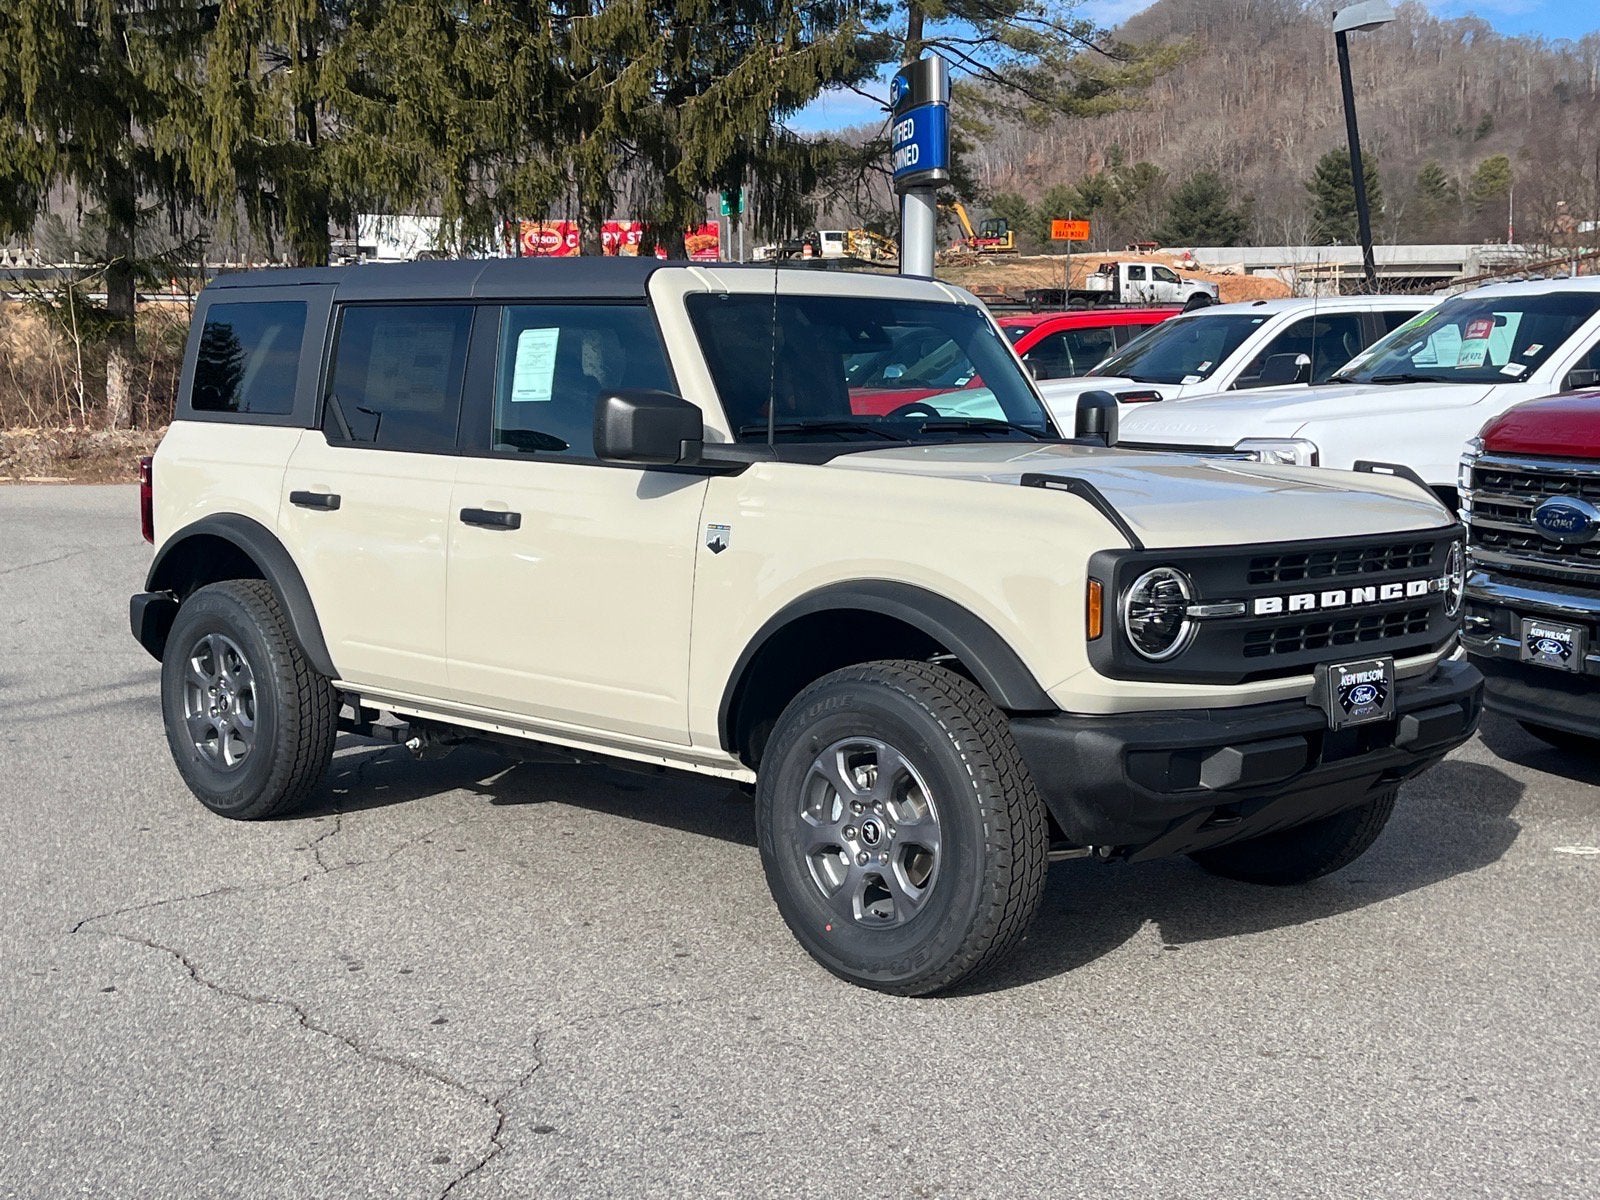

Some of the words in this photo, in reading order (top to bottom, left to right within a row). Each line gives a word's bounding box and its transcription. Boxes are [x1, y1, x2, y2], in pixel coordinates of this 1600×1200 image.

[1254, 579, 1428, 615] BRONCO
[1530, 627, 1544, 638] KEN
[1544, 630, 1571, 642] WILSON
[1340, 673, 1356, 686] KEN
[1356, 669, 1384, 684] WILSON
[1354, 687, 1373, 702] Ford
